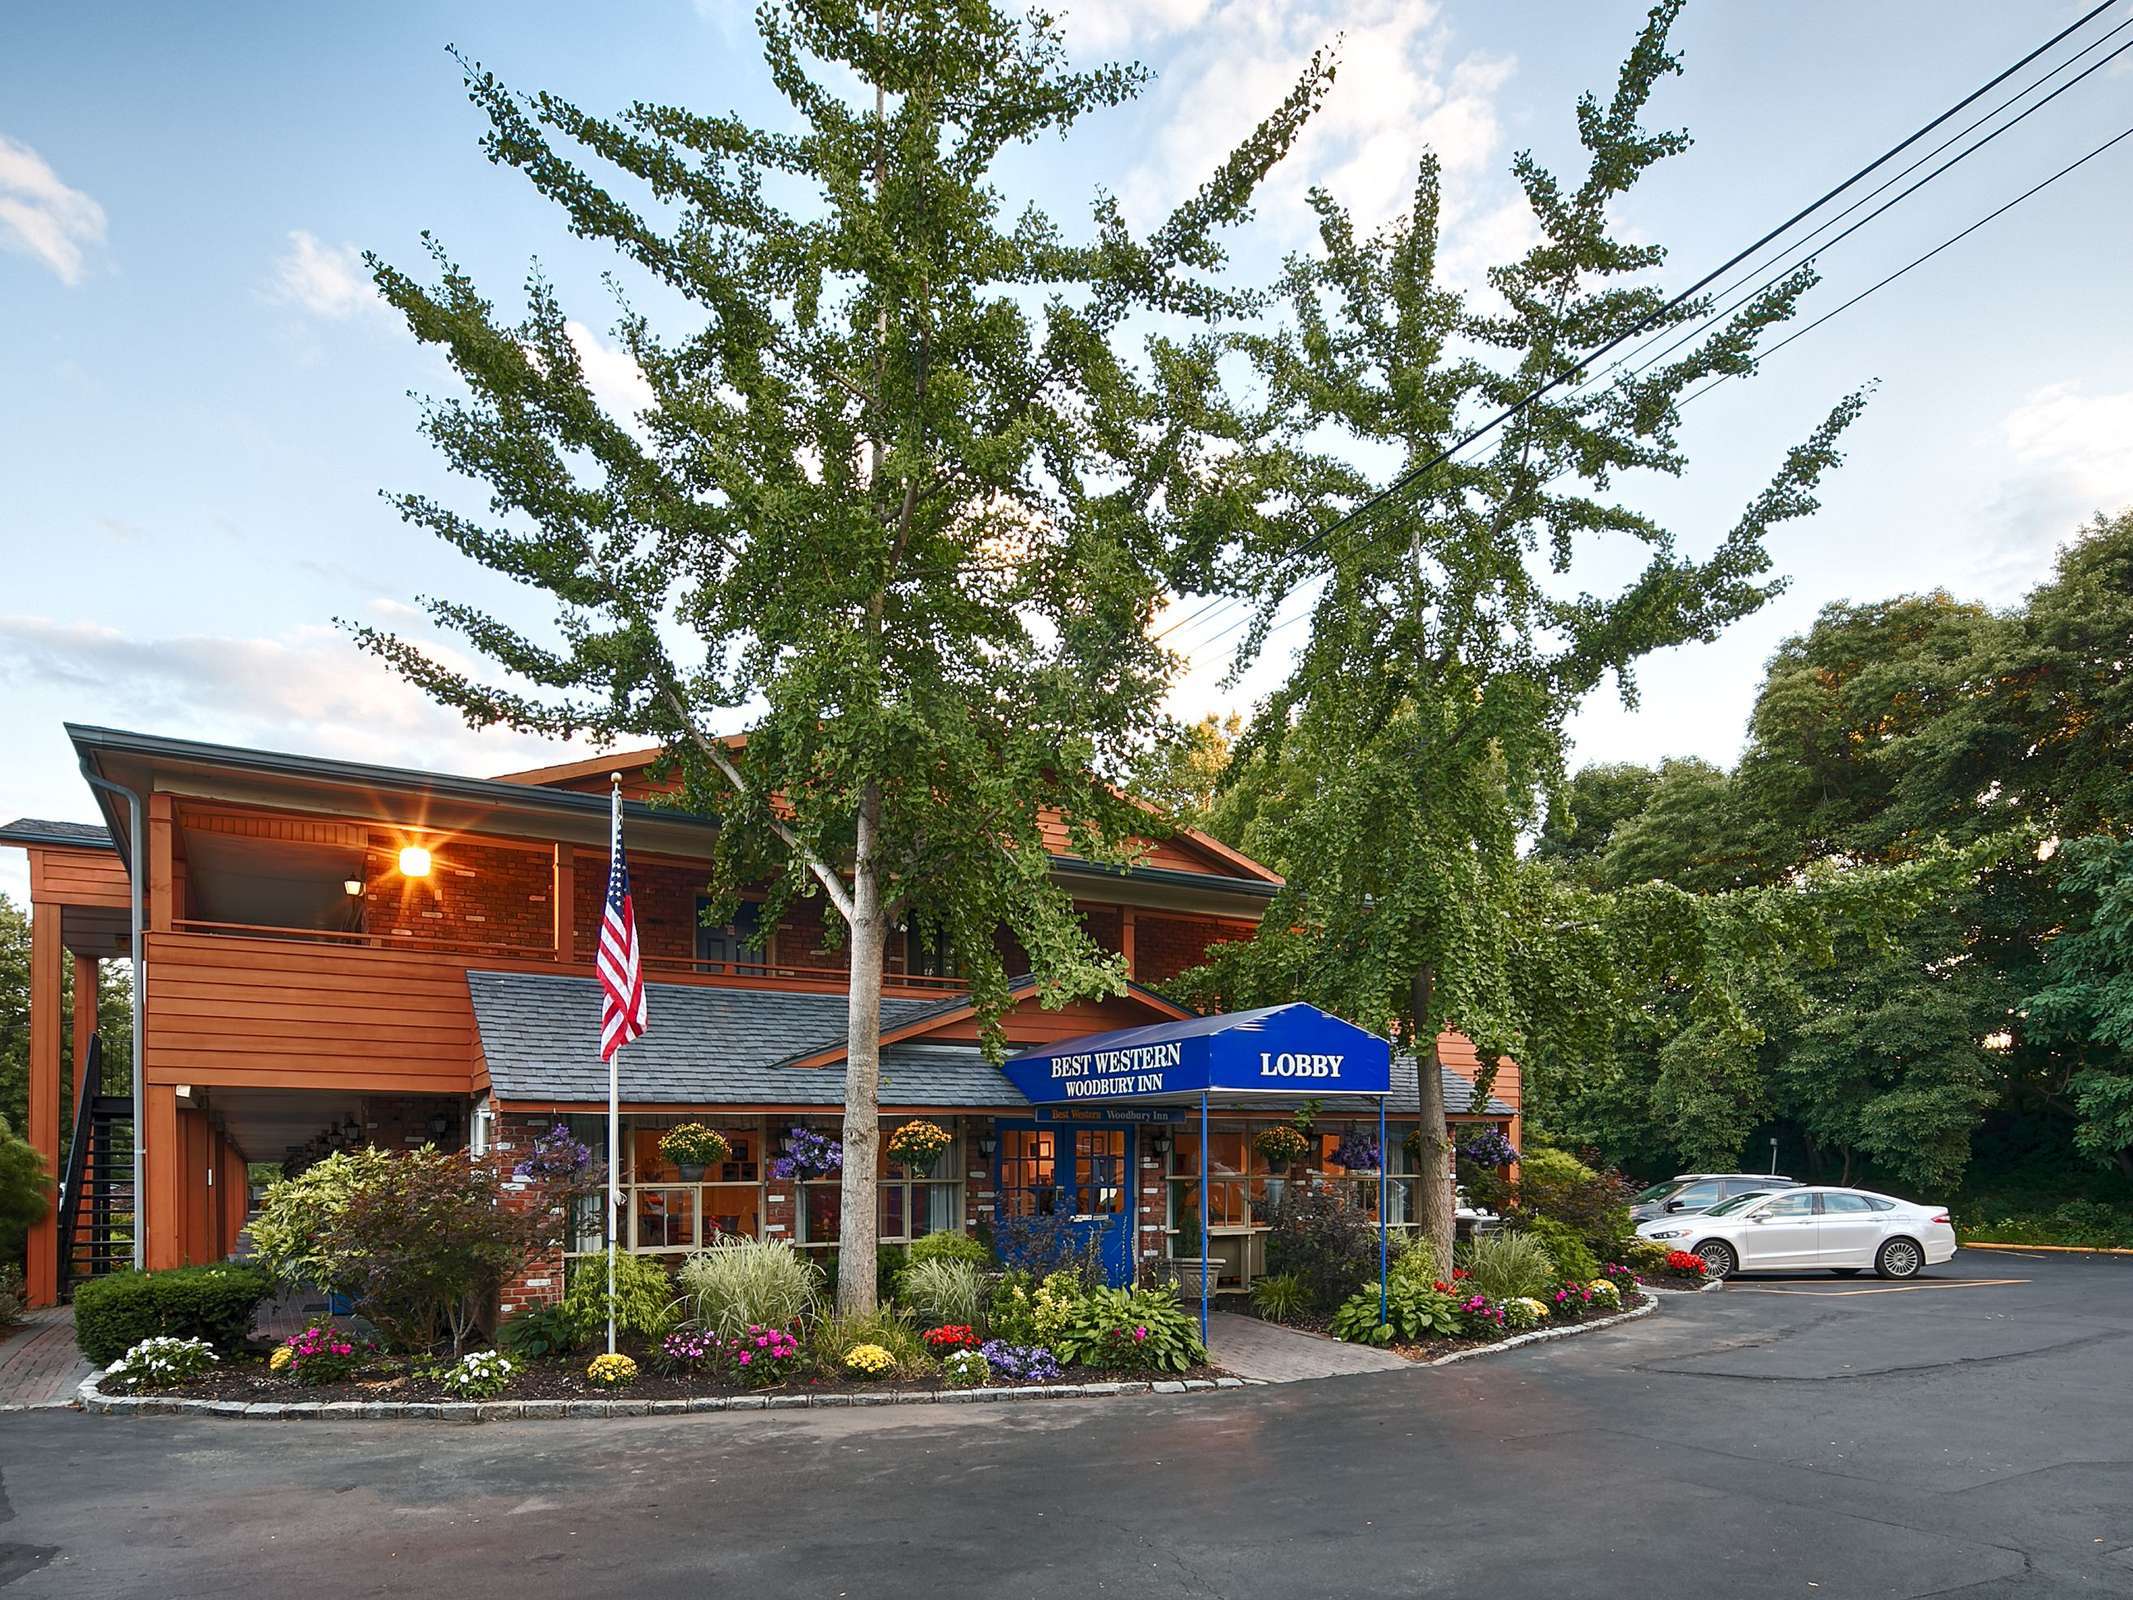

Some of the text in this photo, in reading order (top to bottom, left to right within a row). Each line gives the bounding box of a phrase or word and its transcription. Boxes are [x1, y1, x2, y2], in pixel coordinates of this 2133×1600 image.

[1051, 1042, 1182, 1078] BEST WESTERN
[1260, 1052, 1344, 1077] LOBBY
[1065, 1073, 1163, 1097] WOODBURY INN
[1052, 1110, 1169, 1121] Best Western Woodbury Inn
